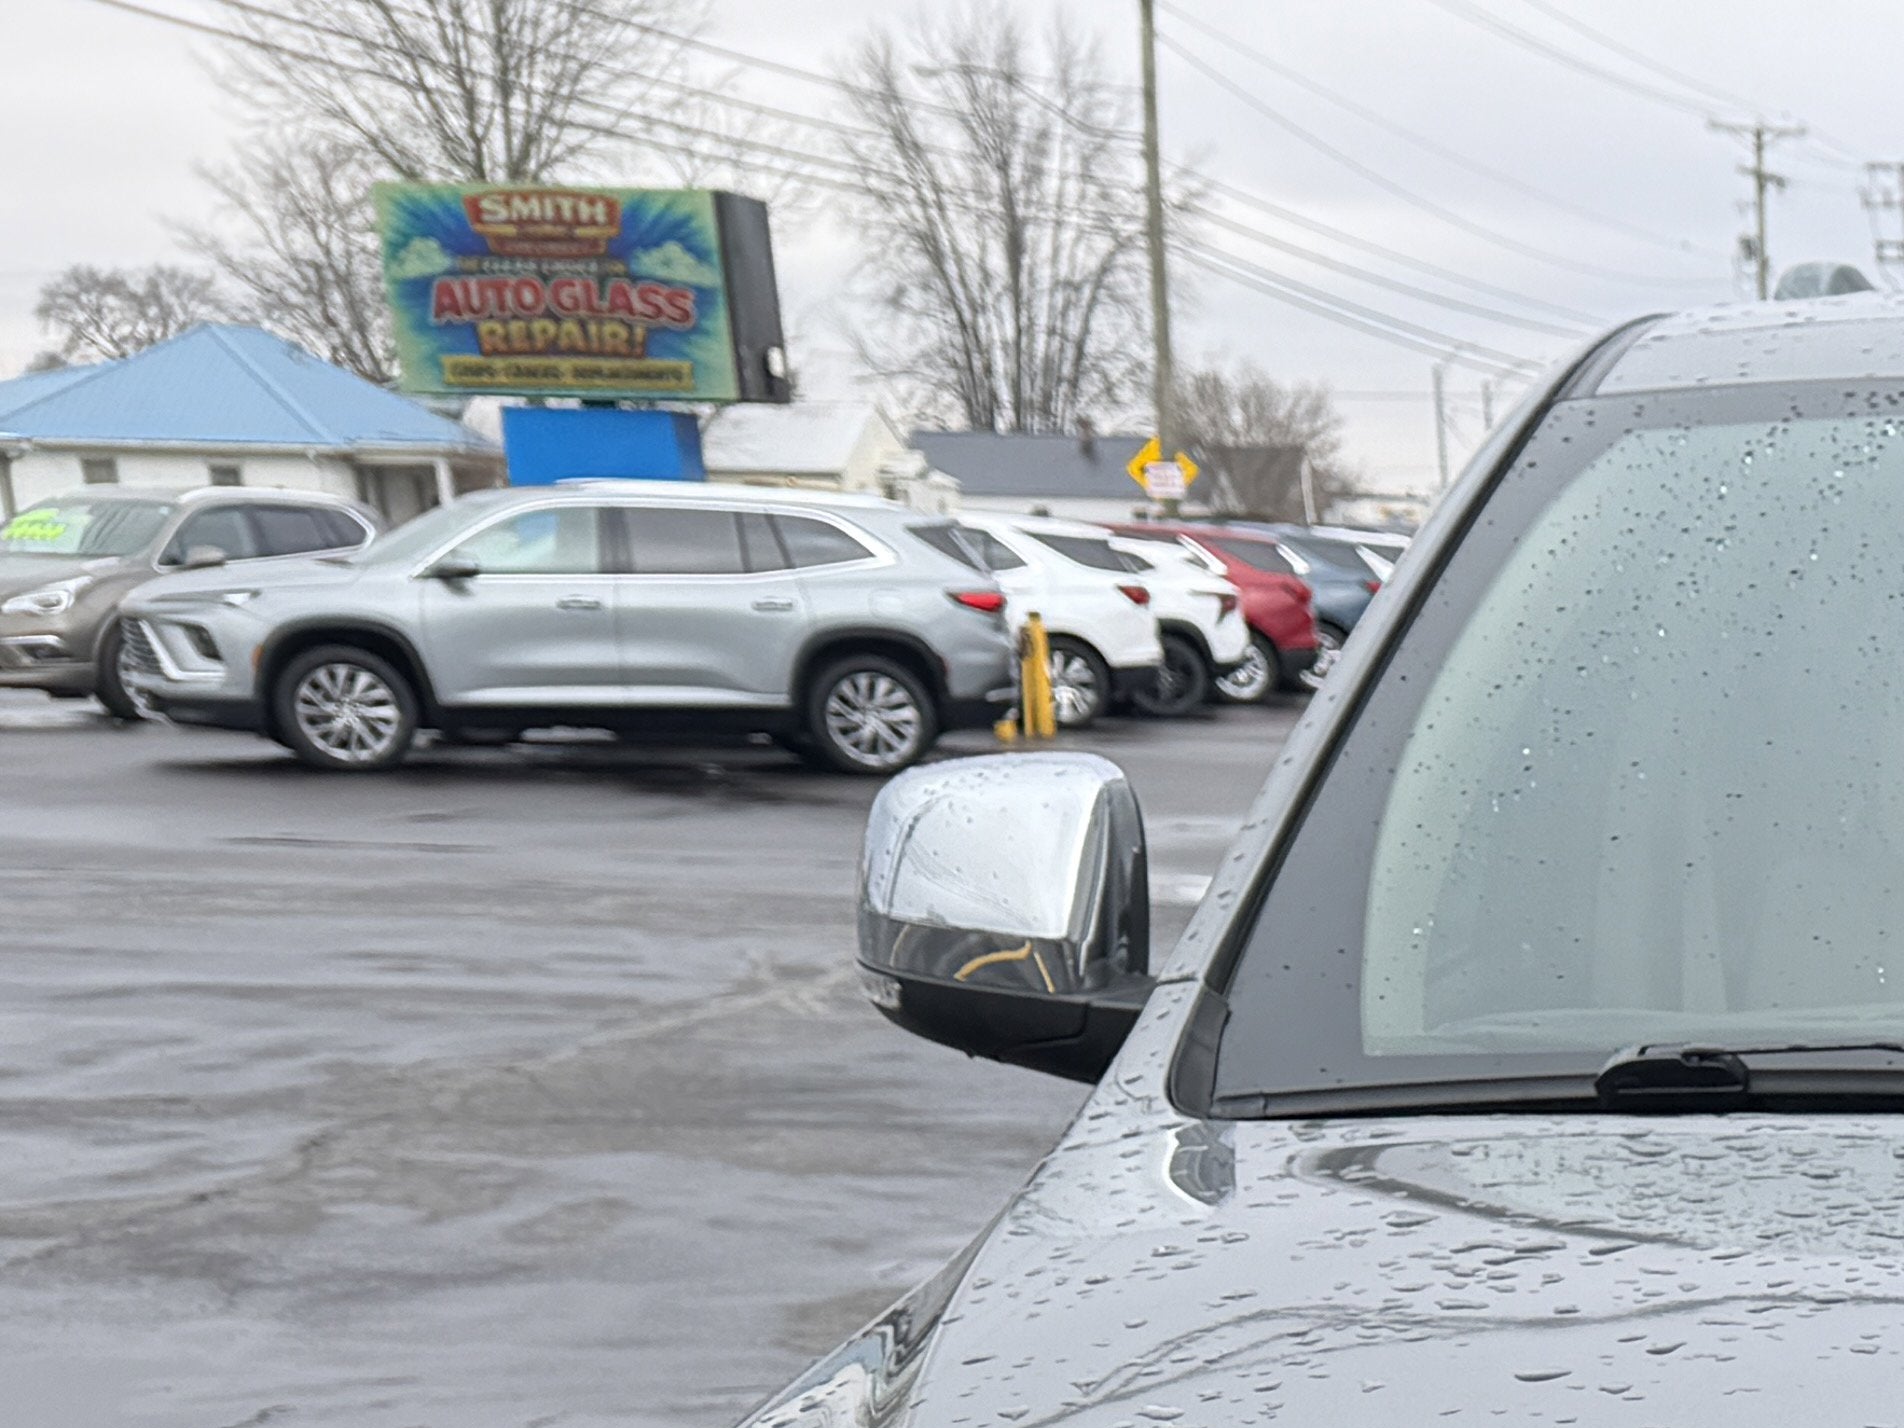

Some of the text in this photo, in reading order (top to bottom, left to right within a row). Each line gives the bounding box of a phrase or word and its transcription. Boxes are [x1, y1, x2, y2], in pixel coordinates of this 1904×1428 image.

[478, 194, 608, 225] SMITH
[432, 277, 695, 326] AUTO GLASS
[477, 318, 647, 358] REPAIR!
